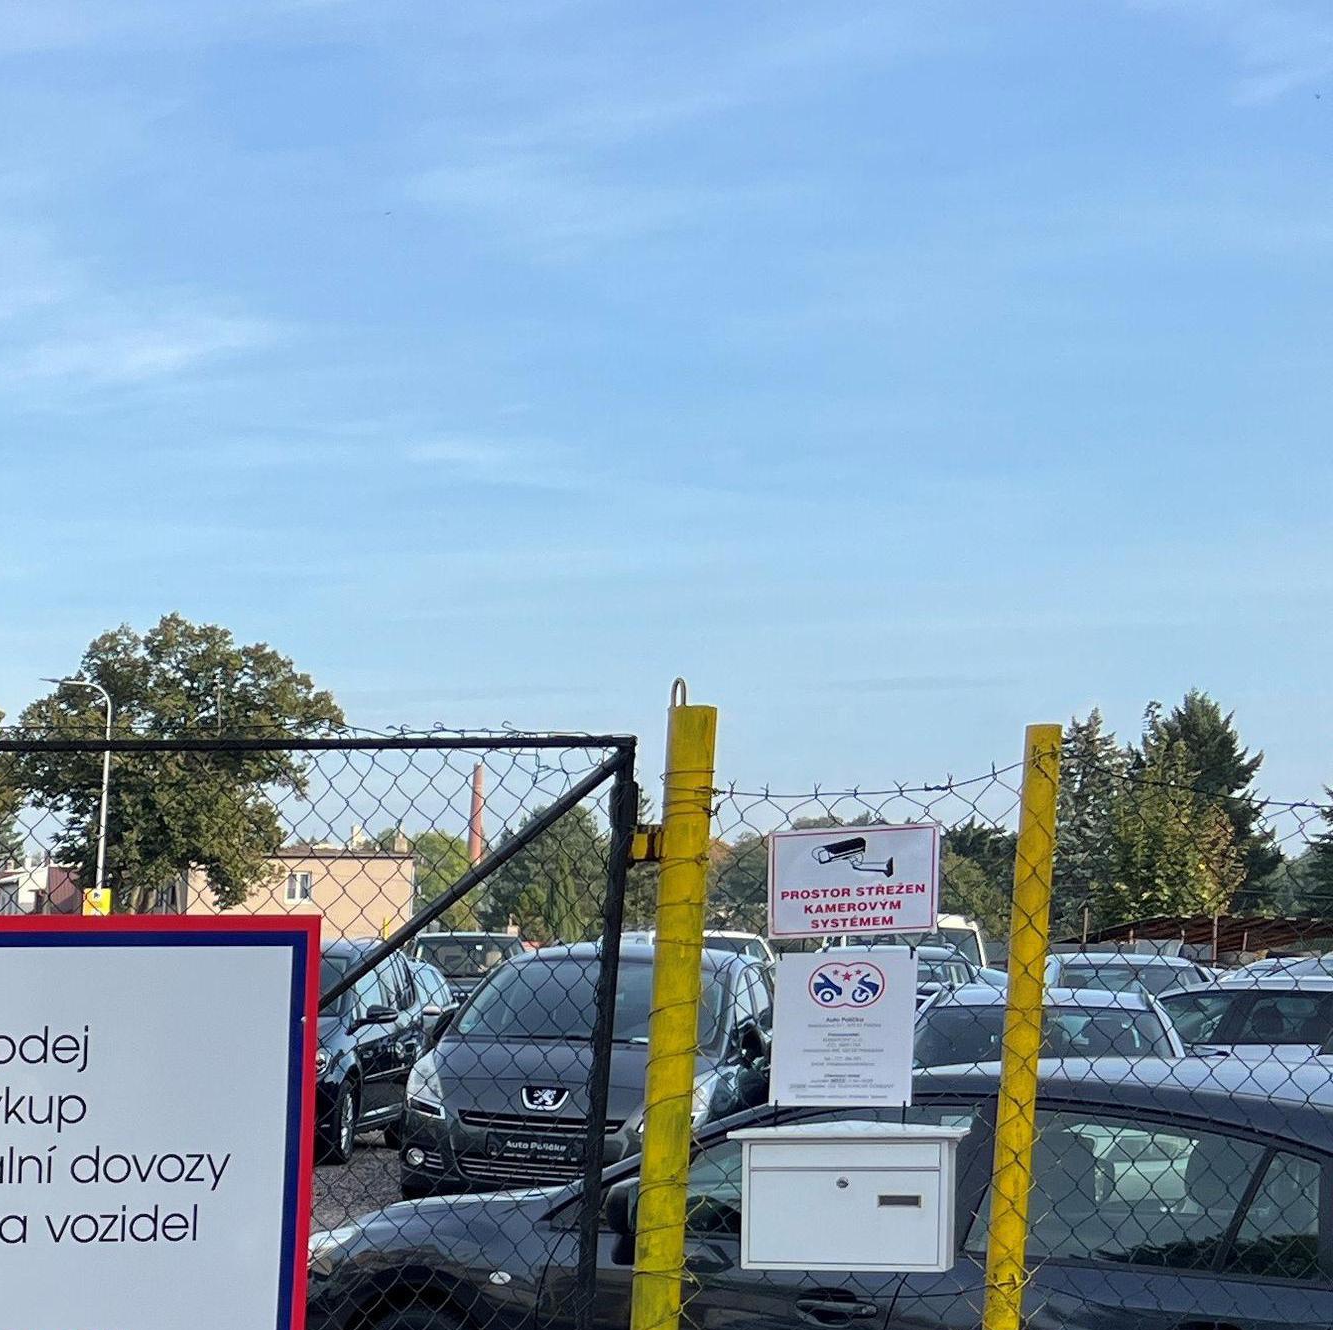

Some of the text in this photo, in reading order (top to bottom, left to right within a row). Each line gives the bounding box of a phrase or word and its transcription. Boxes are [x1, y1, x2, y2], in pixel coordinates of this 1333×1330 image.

[780, 882, 926, 900] PROSTOR STŘEŽEN
[804, 899, 902, 914] KAMEROVÝM
[810, 914, 894, 929] SYSTÉMEM
[69, 1145, 232, 1192] dovozy
[44, 1204, 199, 1244] vozidel
